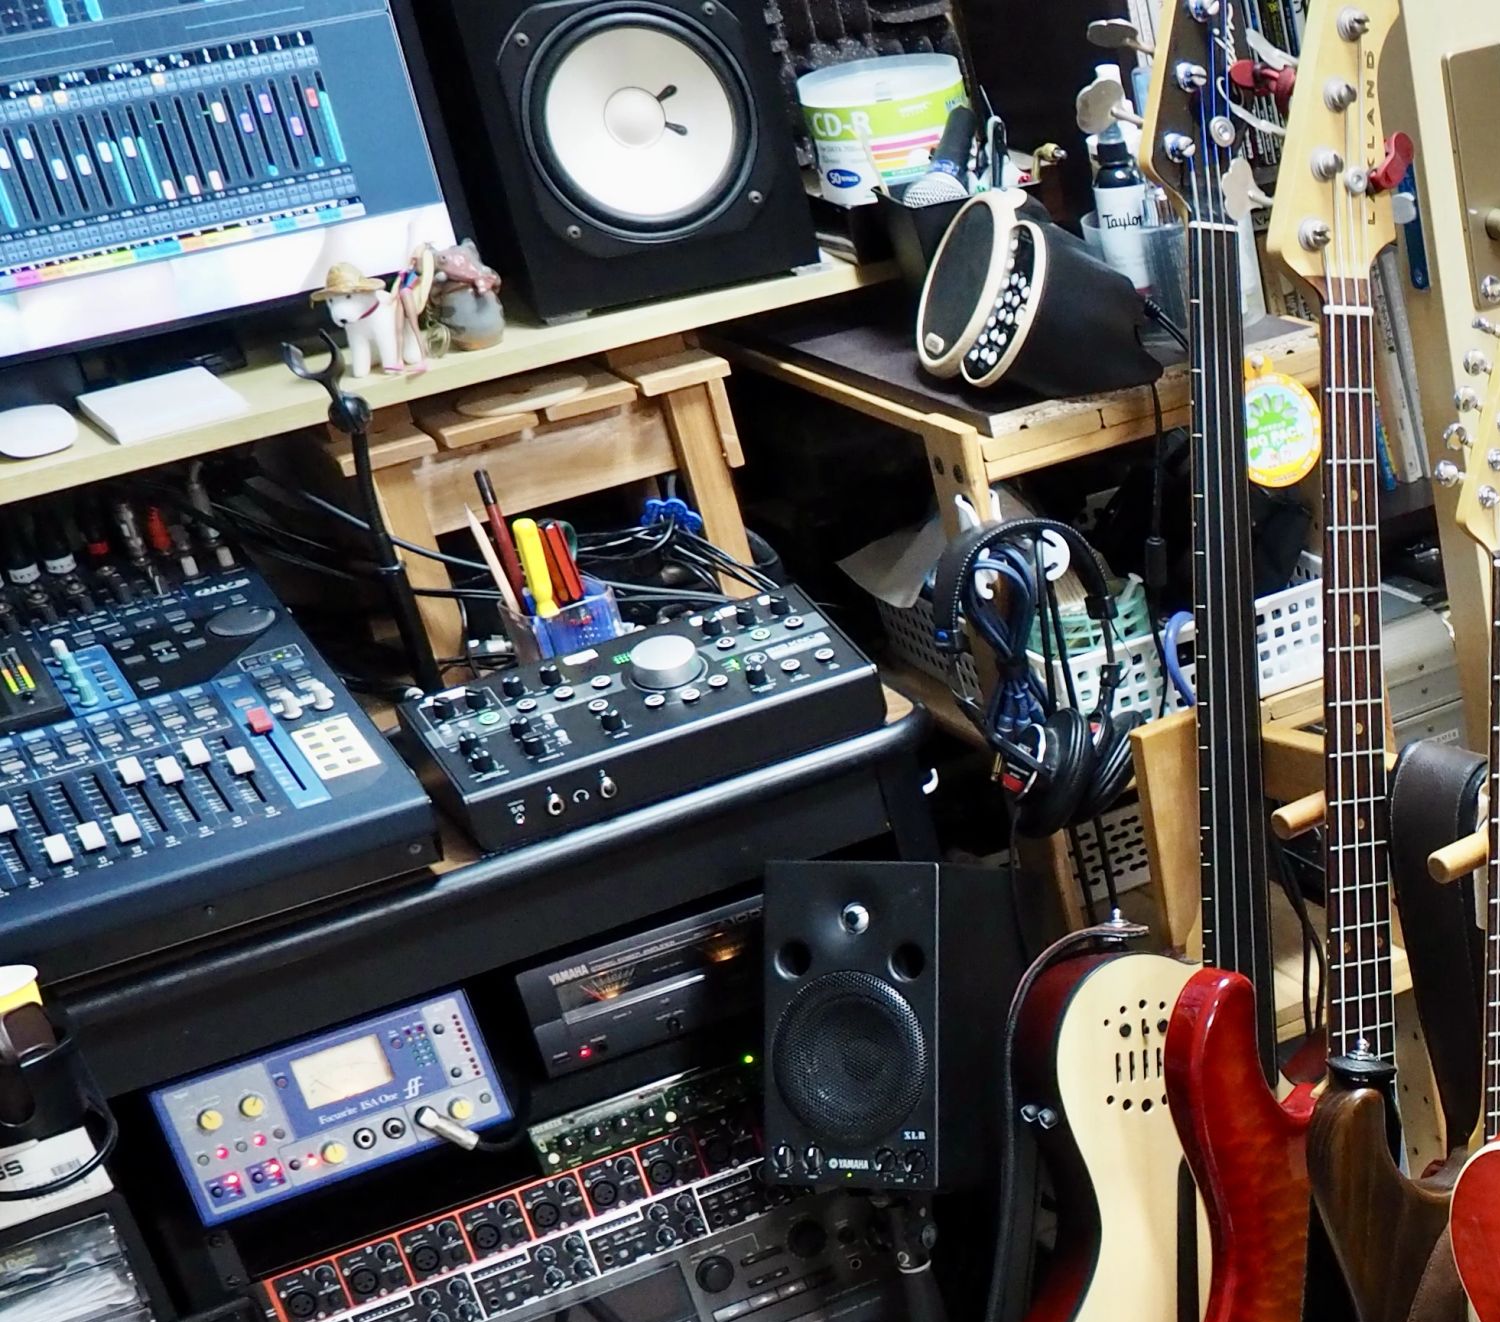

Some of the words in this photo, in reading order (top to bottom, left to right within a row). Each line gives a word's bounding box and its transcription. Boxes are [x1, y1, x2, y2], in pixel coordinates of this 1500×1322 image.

[812, 110, 873, 138] CD-R
[1102, 212, 1143, 231] Taylor
[548, 964, 590, 986] YAMAHA
[318, 1107, 359, 1125] Focusrite
[360, 1097, 381, 1111] ISA
[381, 1092, 399, 1103] One
[838, 1158, 869, 1170] YAMAHA
